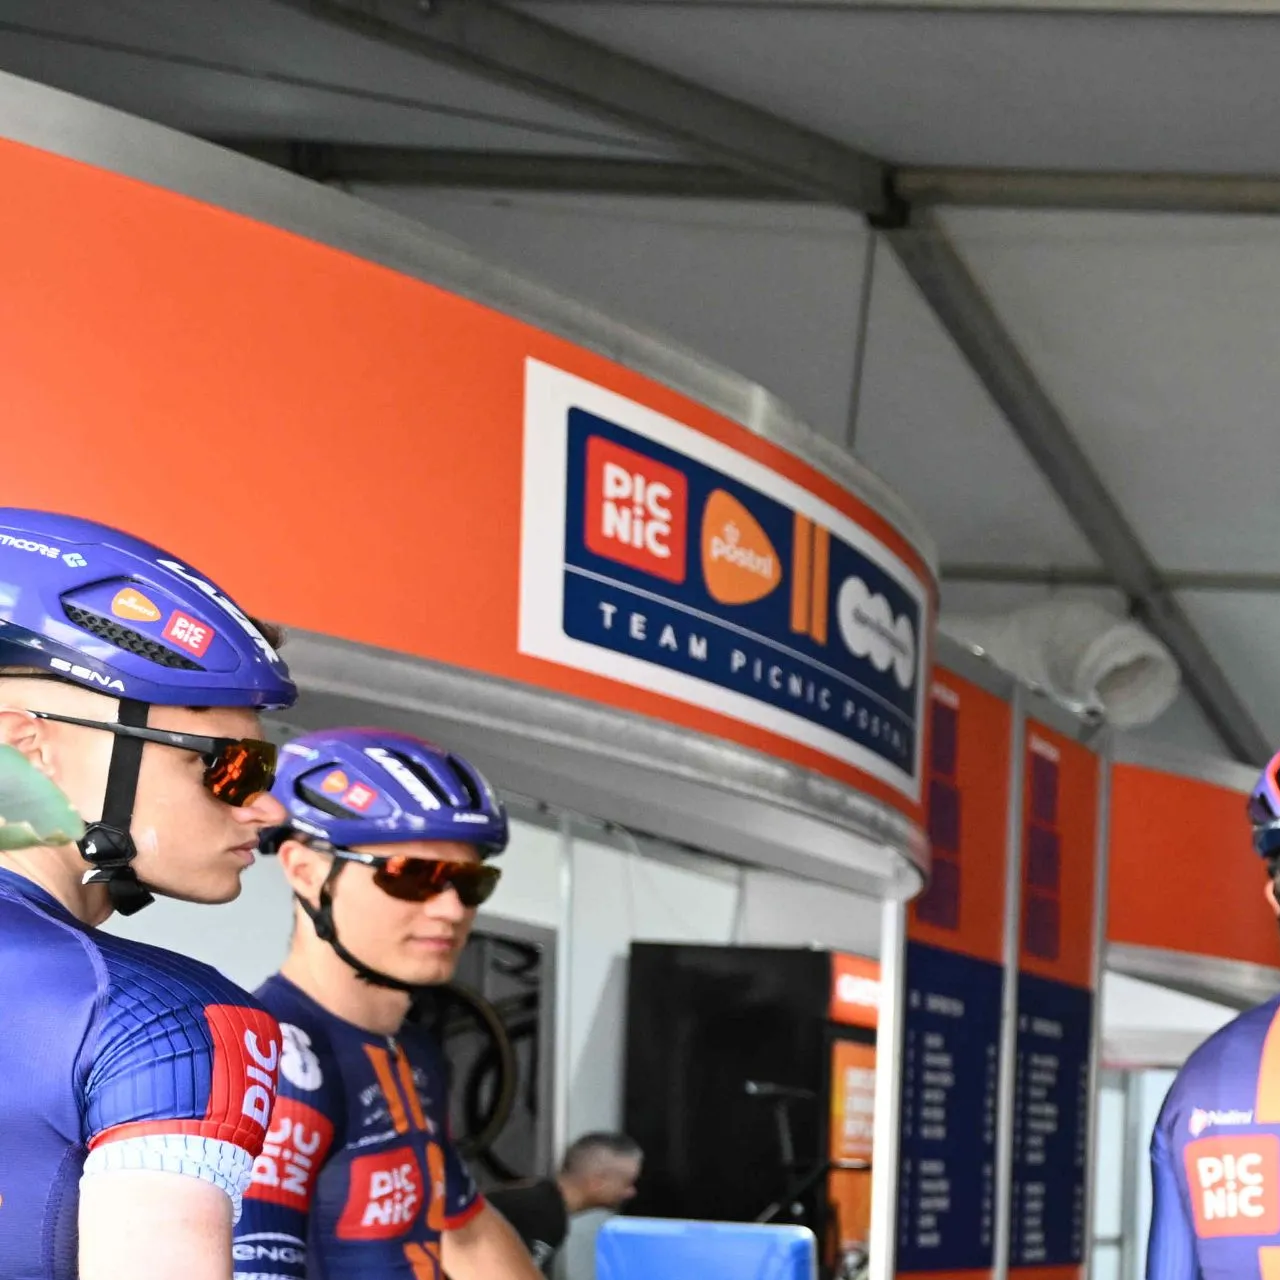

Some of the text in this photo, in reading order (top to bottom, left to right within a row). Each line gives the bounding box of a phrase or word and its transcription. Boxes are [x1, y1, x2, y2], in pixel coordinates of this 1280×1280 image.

[603, 461, 672, 521] PIC
[50, 658, 125, 692] SENA
[600, 602, 707, 660] TEAM
[730, 649, 832, 711] PICNIC
[243, 1028, 277, 1129] PIC
[1197, 1152, 1264, 1188] PIC
